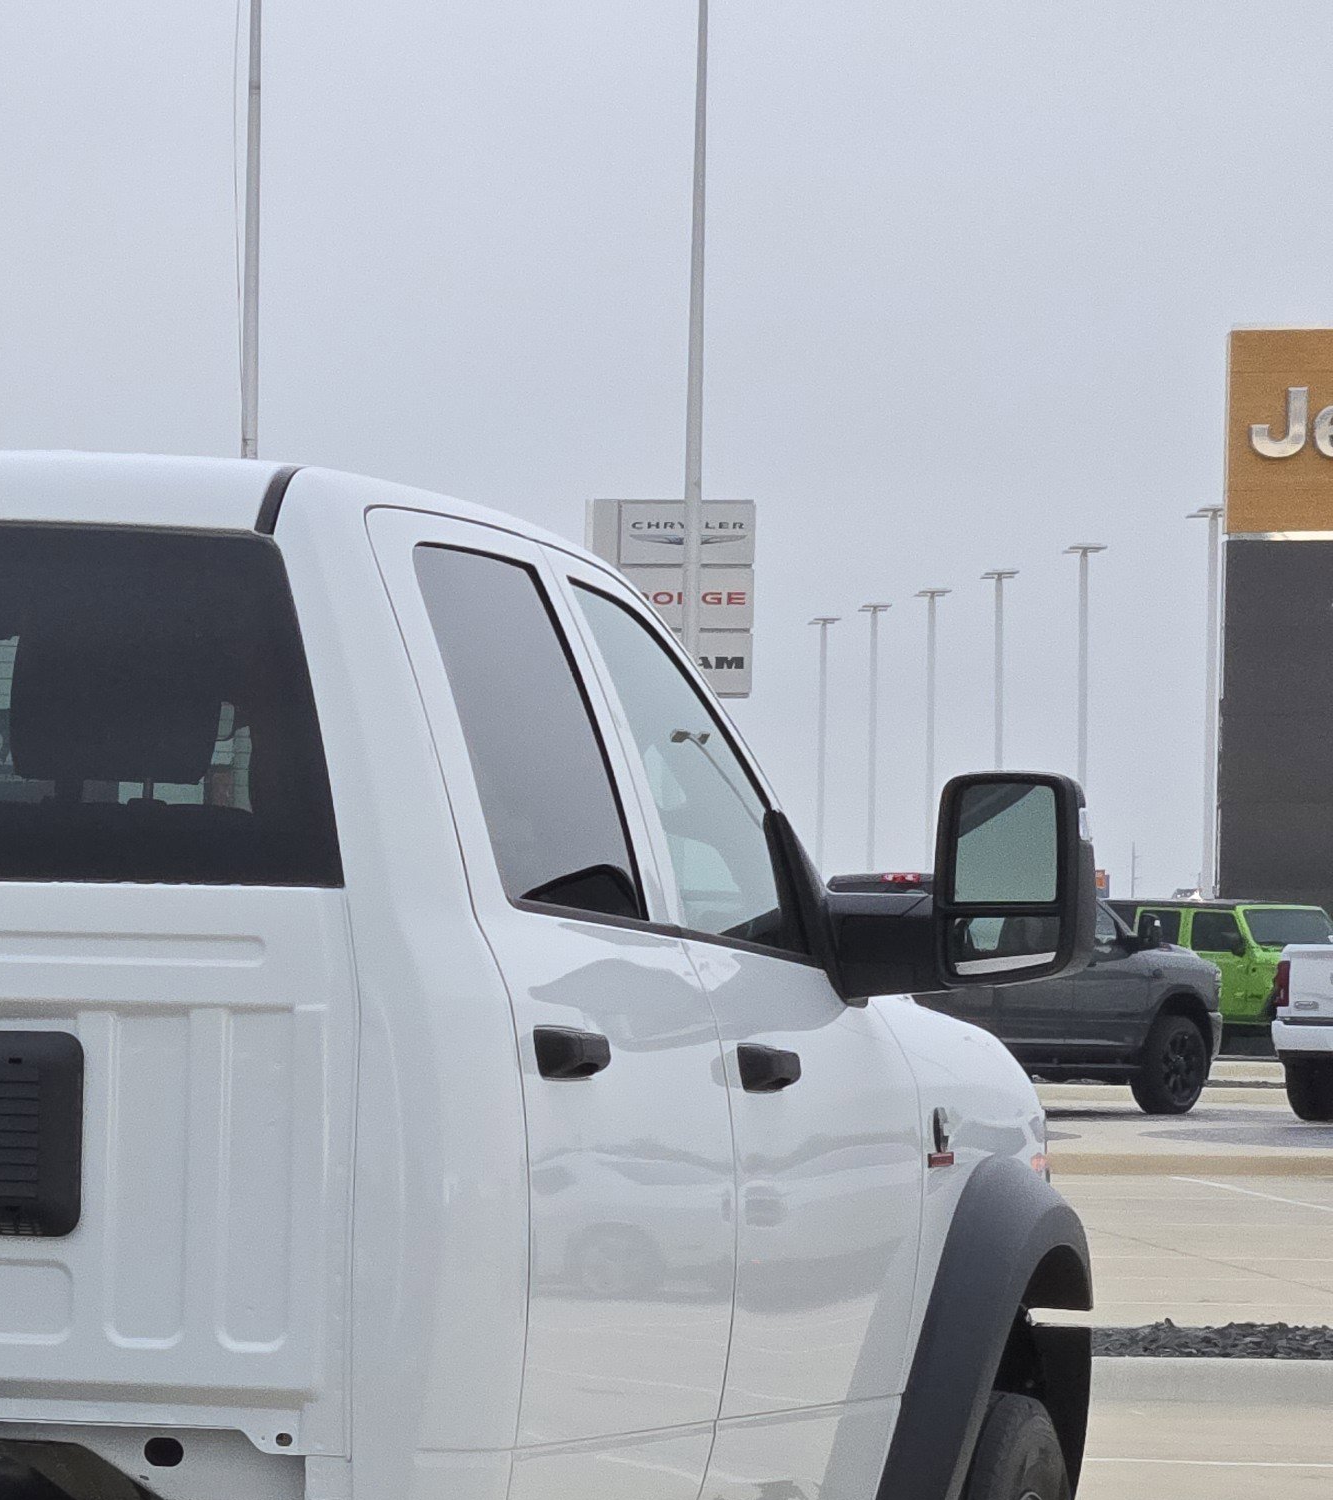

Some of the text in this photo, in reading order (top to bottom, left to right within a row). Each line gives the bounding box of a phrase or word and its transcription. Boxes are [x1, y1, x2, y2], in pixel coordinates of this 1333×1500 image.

[631, 521, 745, 530] CHRYLER
[640, 592, 746, 605] OGE
[698, 656, 745, 670] AM
